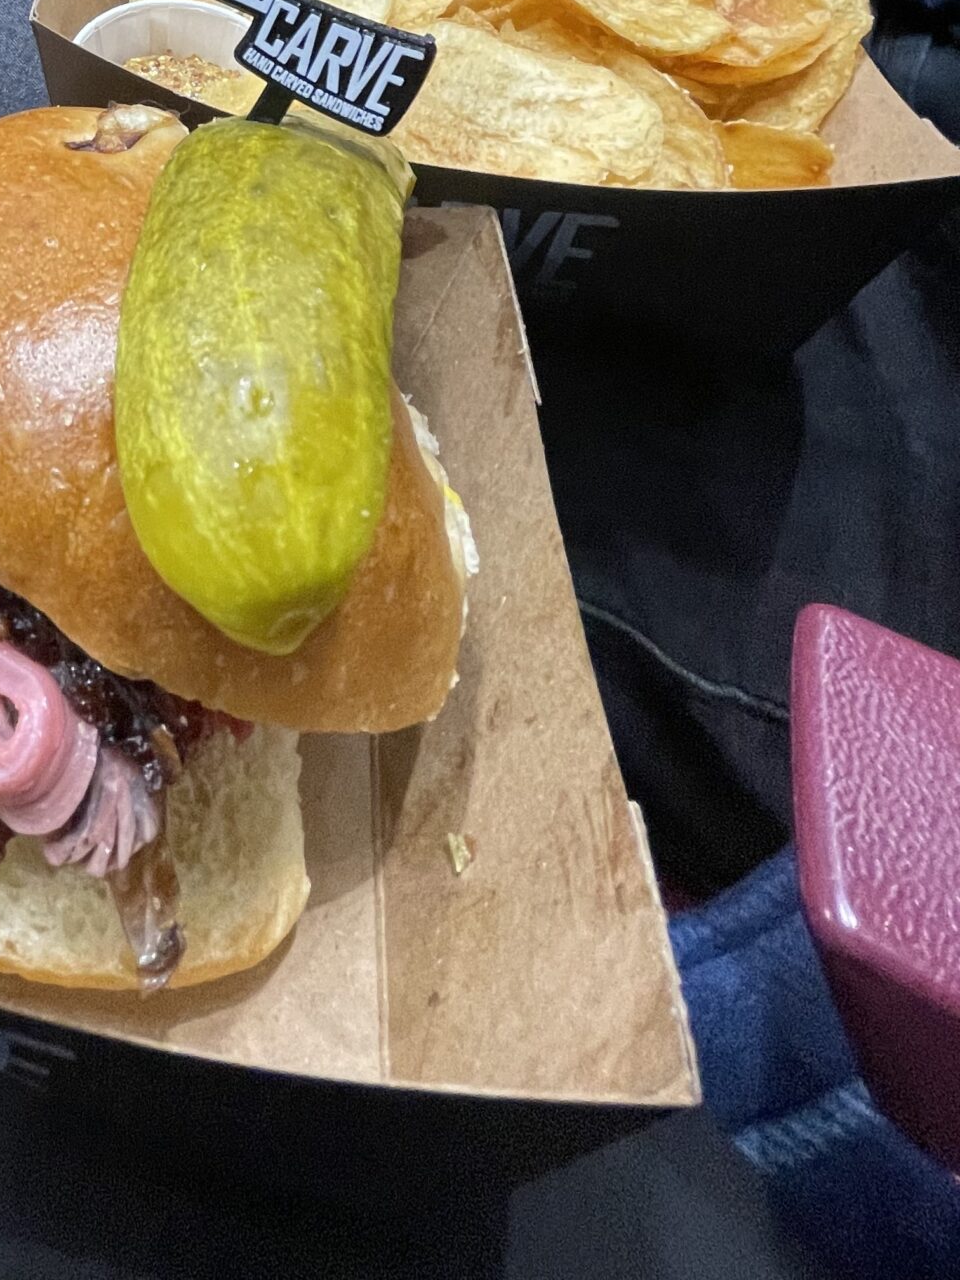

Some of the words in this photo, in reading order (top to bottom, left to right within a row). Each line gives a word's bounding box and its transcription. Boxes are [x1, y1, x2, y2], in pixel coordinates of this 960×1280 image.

[242, 47, 272, 76] HAND
[269, 62, 314, 100] CARVED
[310, 87, 386, 132] SANDWICHES
